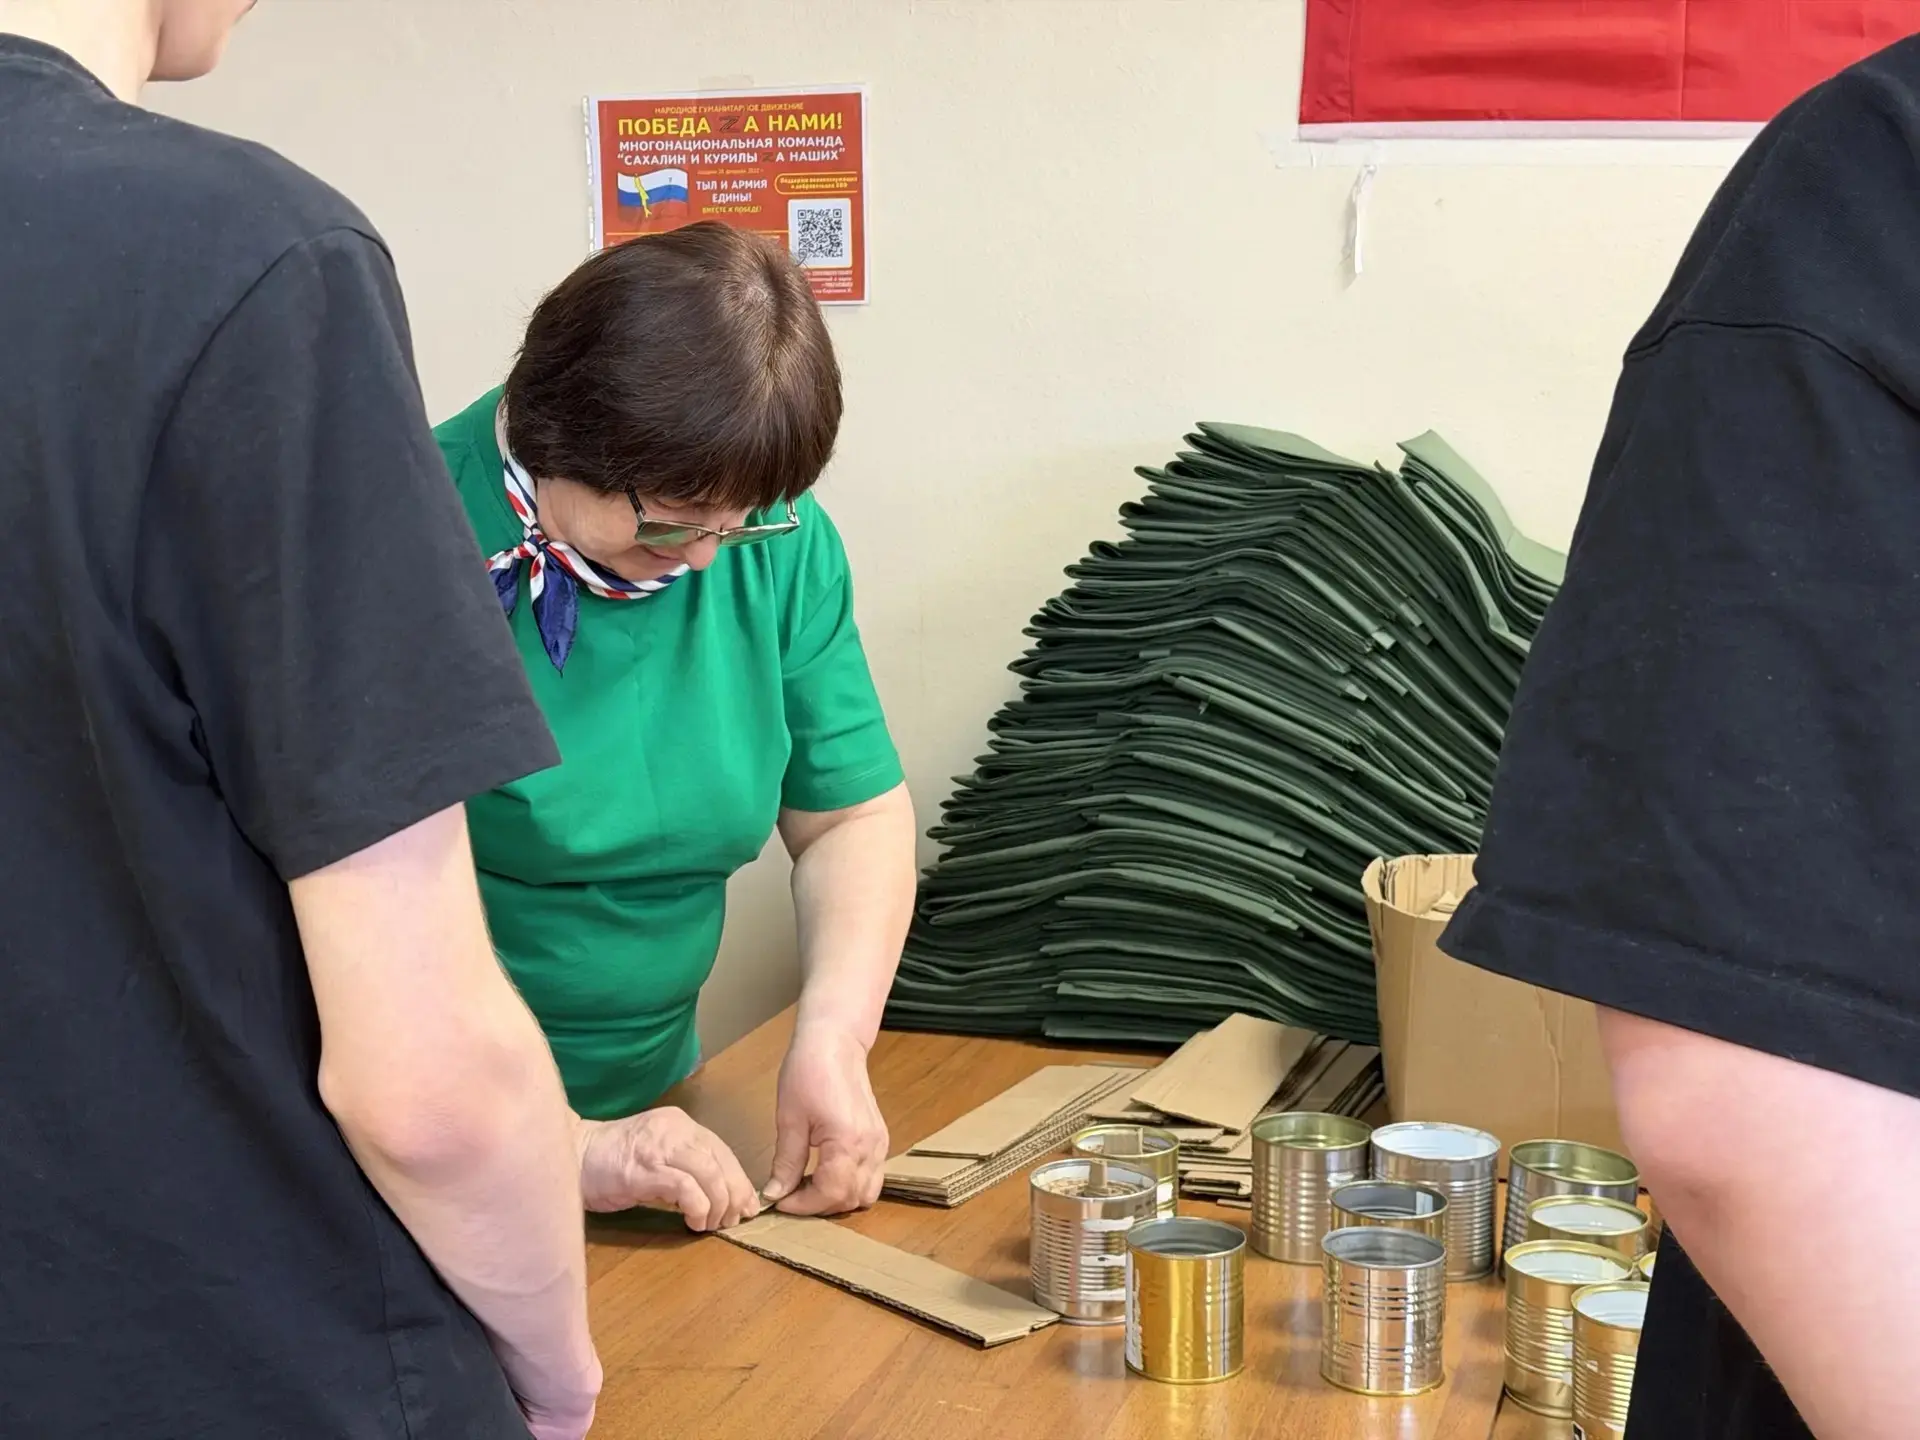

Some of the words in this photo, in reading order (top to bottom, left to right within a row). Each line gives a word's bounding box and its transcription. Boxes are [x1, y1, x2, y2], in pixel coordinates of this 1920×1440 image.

[618, 117, 711, 138] ПОБЕДА
[768, 112, 843, 132] НАМИ!
[619, 137, 772, 152] МНОГОНАЦИОНАЛЬНАЯ
[777, 136, 843, 148] КОМАНДА
[691, 155, 699, 164] И
[704, 153, 758, 165] КУРИЛЫ
[696, 180, 717, 191] ТЫЛ
[721, 180, 728, 190] И
[731, 179, 768, 189] АРМИЯ
[712, 192, 752, 204] ЕДИНЫ!
